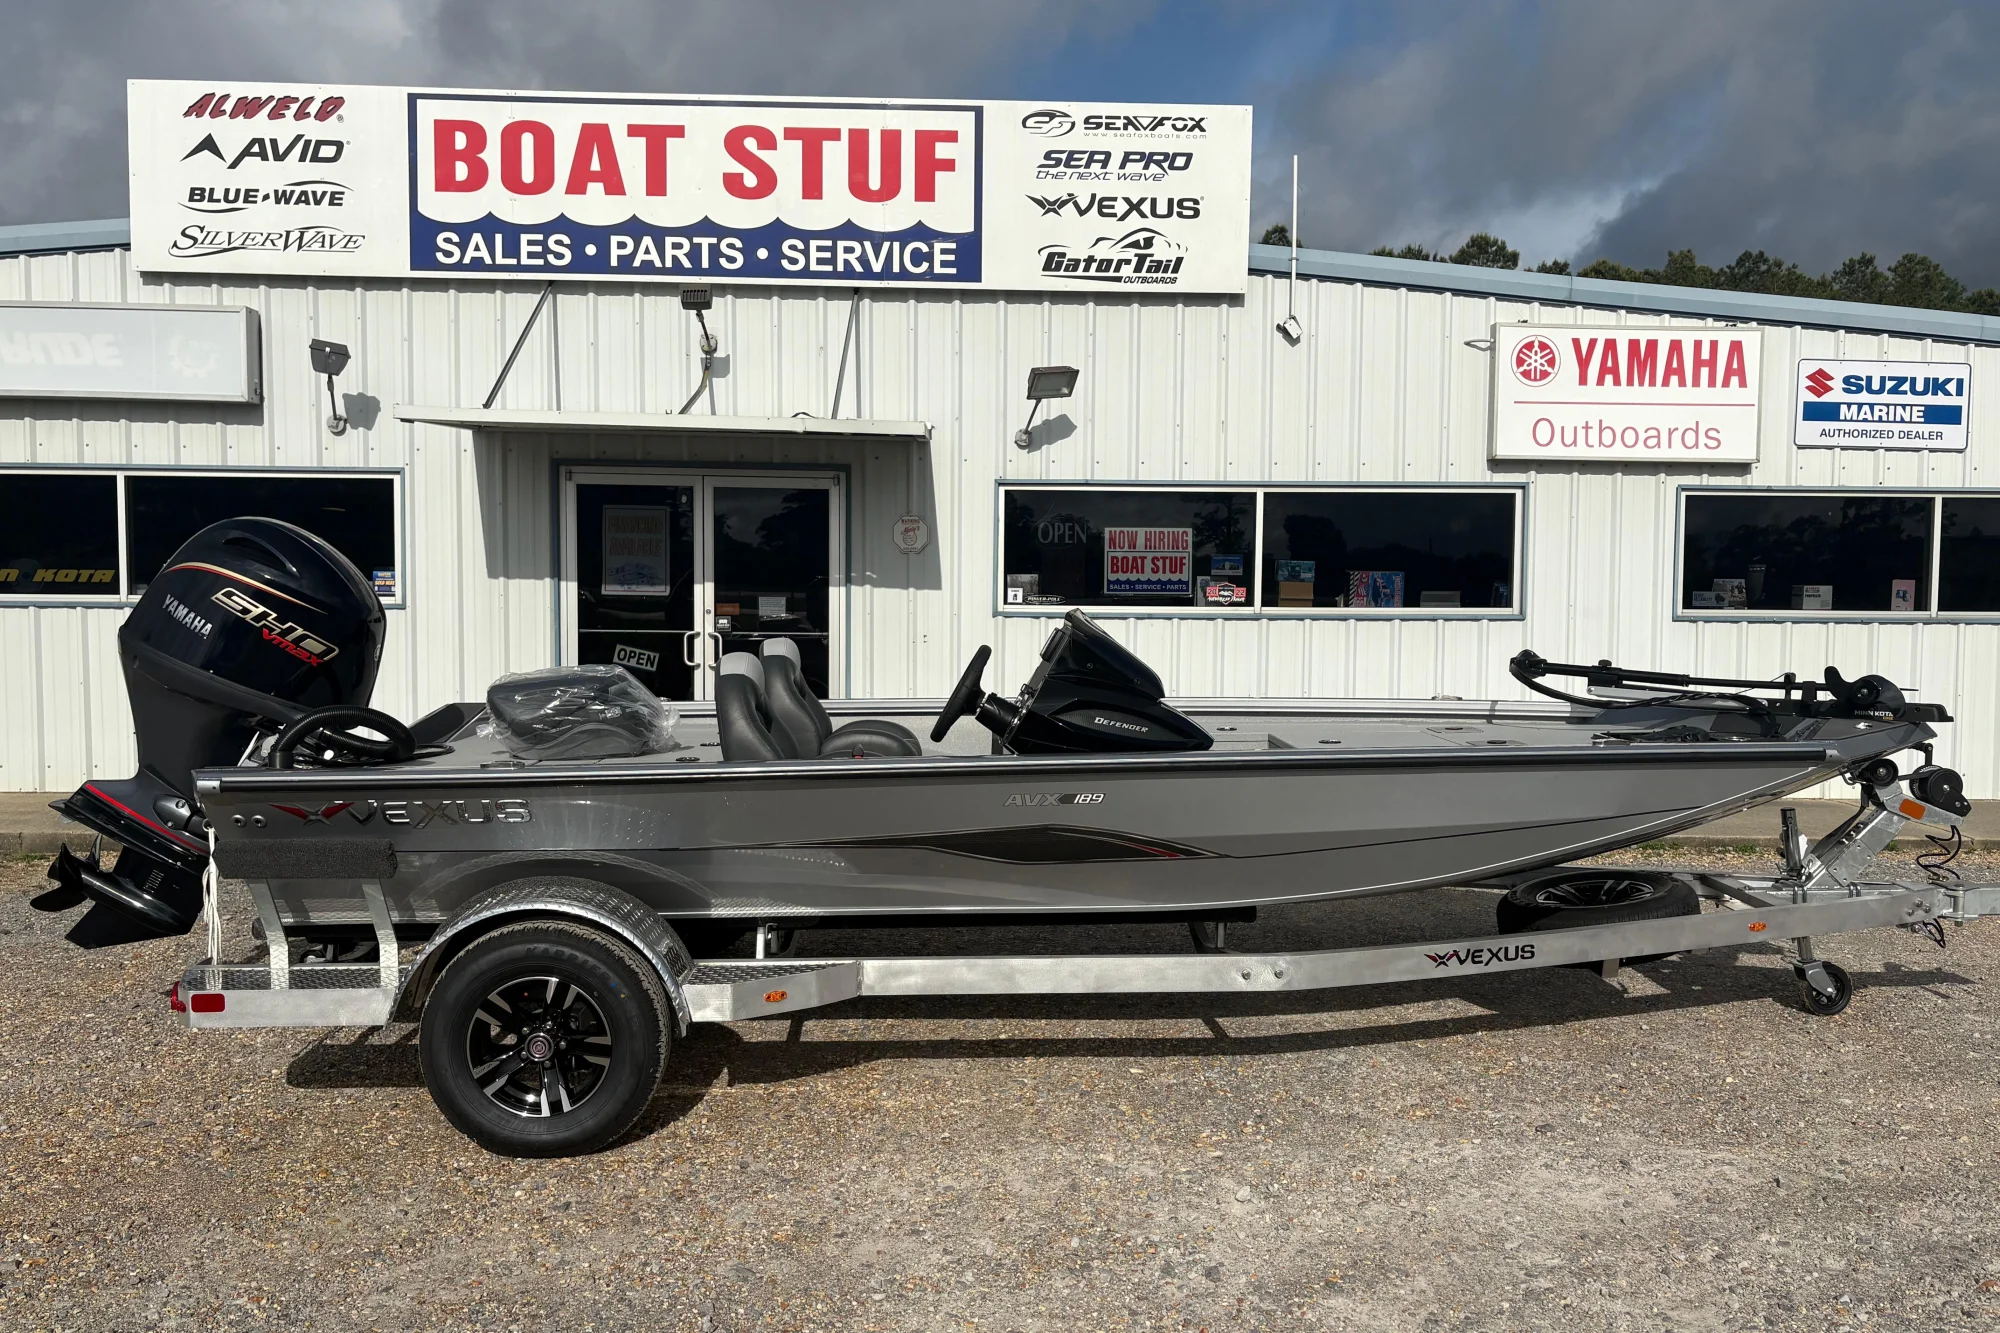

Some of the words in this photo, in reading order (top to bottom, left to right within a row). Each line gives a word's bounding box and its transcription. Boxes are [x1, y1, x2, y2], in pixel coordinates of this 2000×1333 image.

[183, 92, 346, 122] ALWELD
[227, 134, 344, 169] AVID
[434, 119, 685, 196] BOAT
[722, 125, 958, 203] STUF
[1036, 150, 1111, 169] SEA
[1118, 152, 1193, 175] PRO
[1036, 170, 1067, 180] the
[1070, 171, 1113, 181] next
[1117, 173, 1166, 182] wave
[188, 187, 259, 204] BLUE
[273, 189, 345, 206] WAVE
[1066, 193, 1201, 221] VEXUS
[435, 232, 572, 266] SALES
[610, 235, 744, 269] PARTS
[780, 239, 957, 274] SERVICE
[1123, 276, 1178, 284] OUTBOARDS
[1572, 338, 1747, 388] YAMAHA
[1842, 375, 1964, 397] SUZUKI
[1840, 404, 1924, 422] MARINE
[1532, 418, 1722, 450] Outboards
[1819, 428, 1894, 440] AUTHORIZED
[1898, 430, 1943, 441] DEALER
[1038, 523, 1087, 543] OPEN
[1108, 530, 1138, 550] NOW
[1144, 531, 1189, 550] HIRING
[32, 569, 115, 583] KOTA
[1110, 556, 1147, 574] BOAT
[1151, 556, 1187, 574] STUF
[162, 594, 213, 636] YAMAHA
[210, 587, 340, 661] SHO
[616, 648, 656, 669] OPEN
[1094, 716, 1149, 733] DEFENDER
[1003, 793, 1063, 807] AVX
[1073, 793, 1106, 804] 189
[334, 800, 532, 829] VEXUS
[1452, 944, 1536, 966] VEXUS
